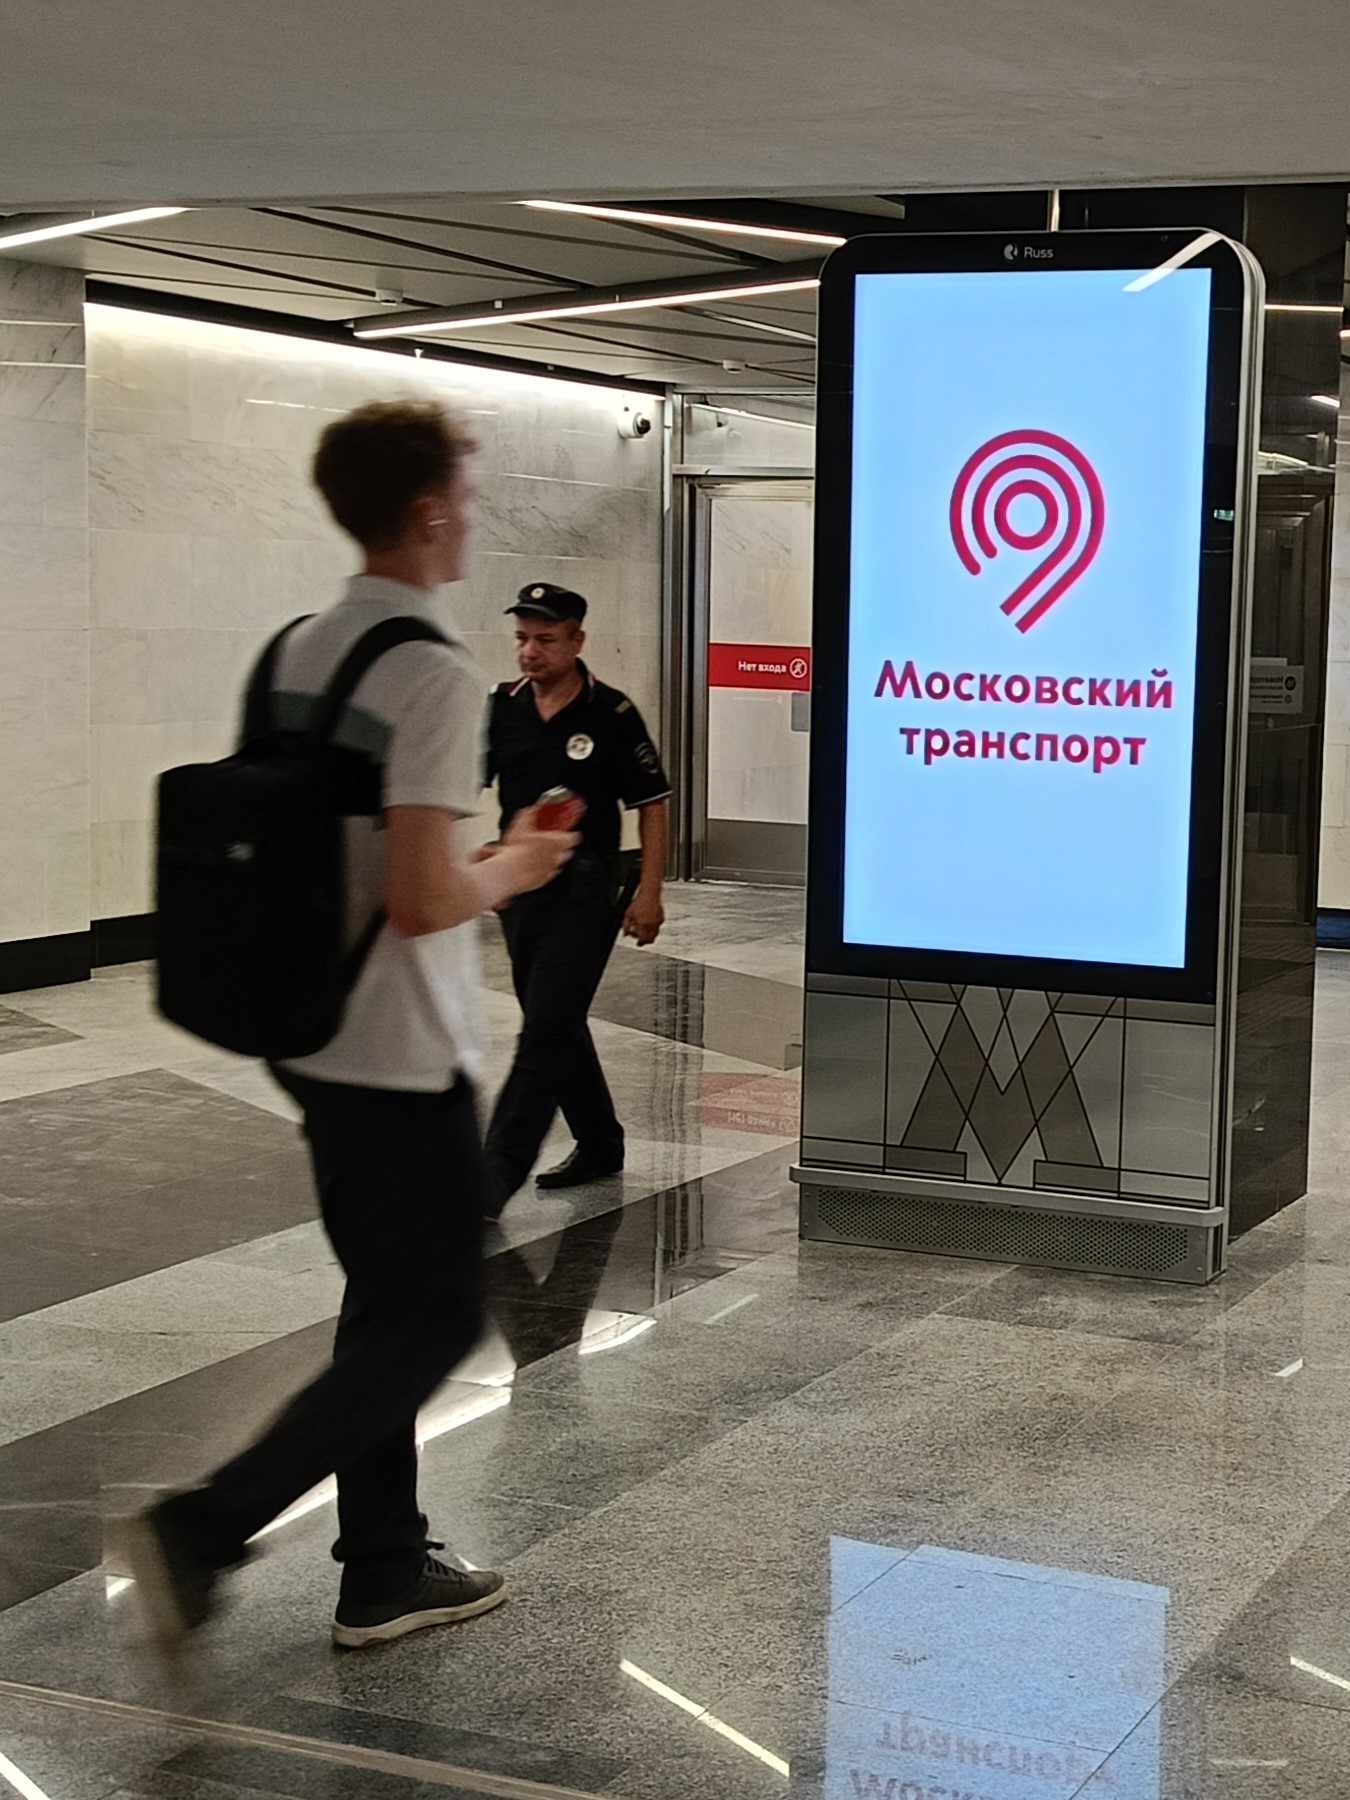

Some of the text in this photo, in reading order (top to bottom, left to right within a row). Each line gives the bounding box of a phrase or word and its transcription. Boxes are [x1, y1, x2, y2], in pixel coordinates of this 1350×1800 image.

[1024, 247, 1054, 258] Russ
[738, 661, 787, 673] Нет входа
[874, 660, 1173, 709] Московский
[900, 727, 1148, 774] транспорт
